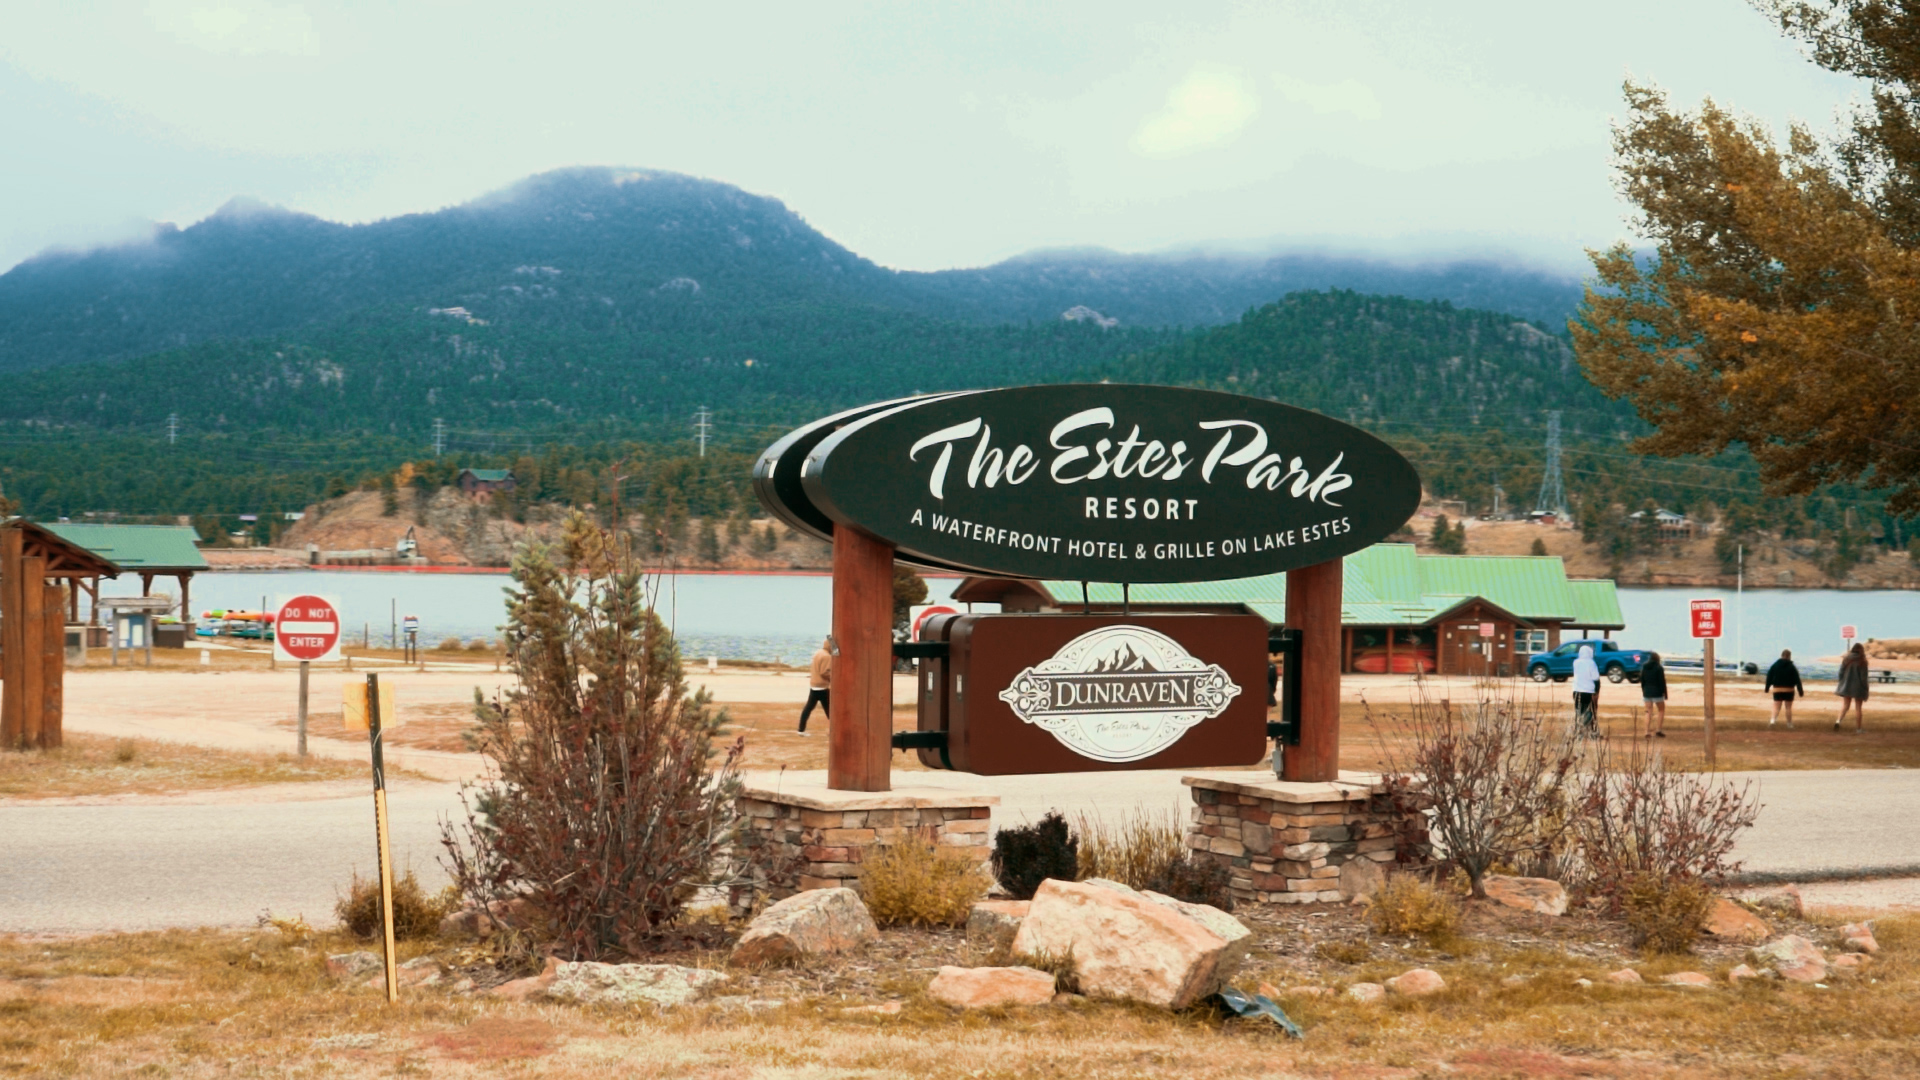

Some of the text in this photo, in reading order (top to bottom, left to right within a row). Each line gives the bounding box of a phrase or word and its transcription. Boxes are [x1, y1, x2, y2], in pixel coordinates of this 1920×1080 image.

[910, 406, 1353, 507] The Estes Park
[1085, 496, 1198, 520] RESORT
[910, 508, 1352, 560] A WATERFRONT HOTEL & GRILLE ON LAKE ESTES
[1692, 602, 1720, 610] ENTERING
[285, 607, 332, 618] DO NOT
[1700, 611, 1713, 620] FEE
[1698, 621, 1716, 630] AREA
[289, 636, 325, 648] ENTER
[1055, 679, 1190, 708] DUNRAVEN
